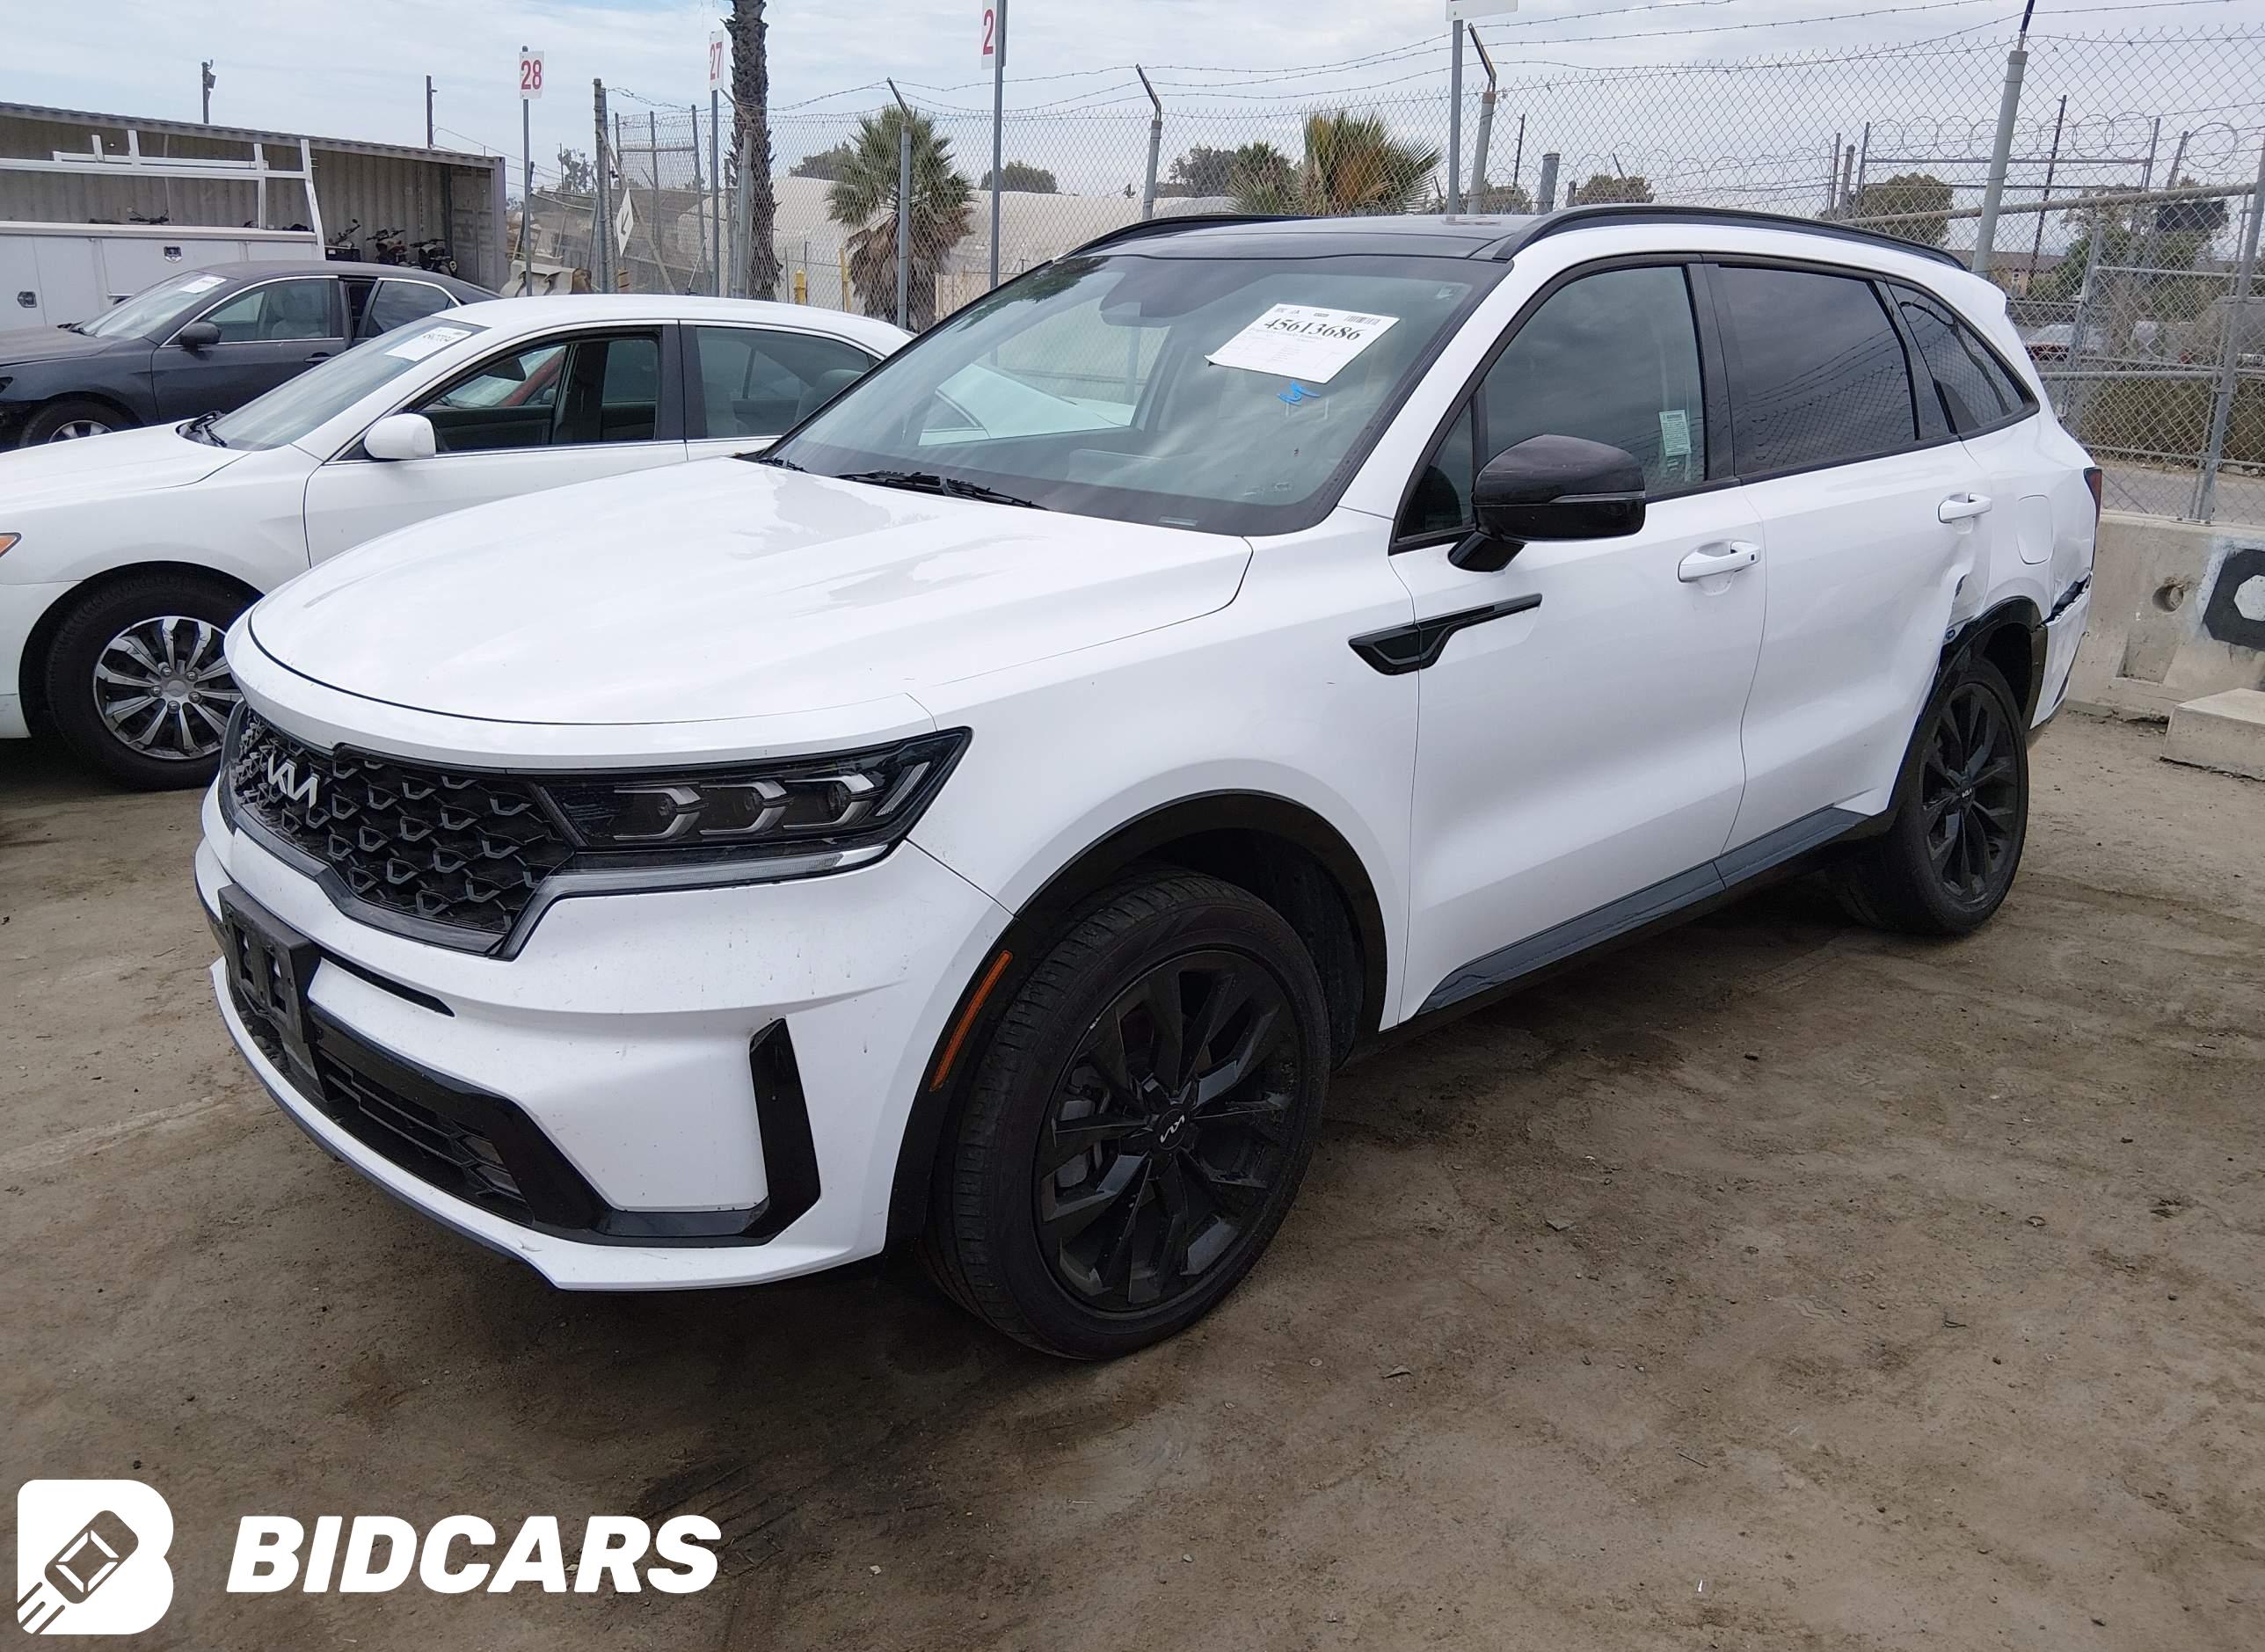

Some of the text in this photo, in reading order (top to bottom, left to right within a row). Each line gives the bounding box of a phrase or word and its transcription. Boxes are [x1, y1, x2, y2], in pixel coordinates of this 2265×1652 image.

[521, 59, 542, 90] 28
[710, 41, 723, 80] 27
[1264, 317, 1366, 341] 45613686
